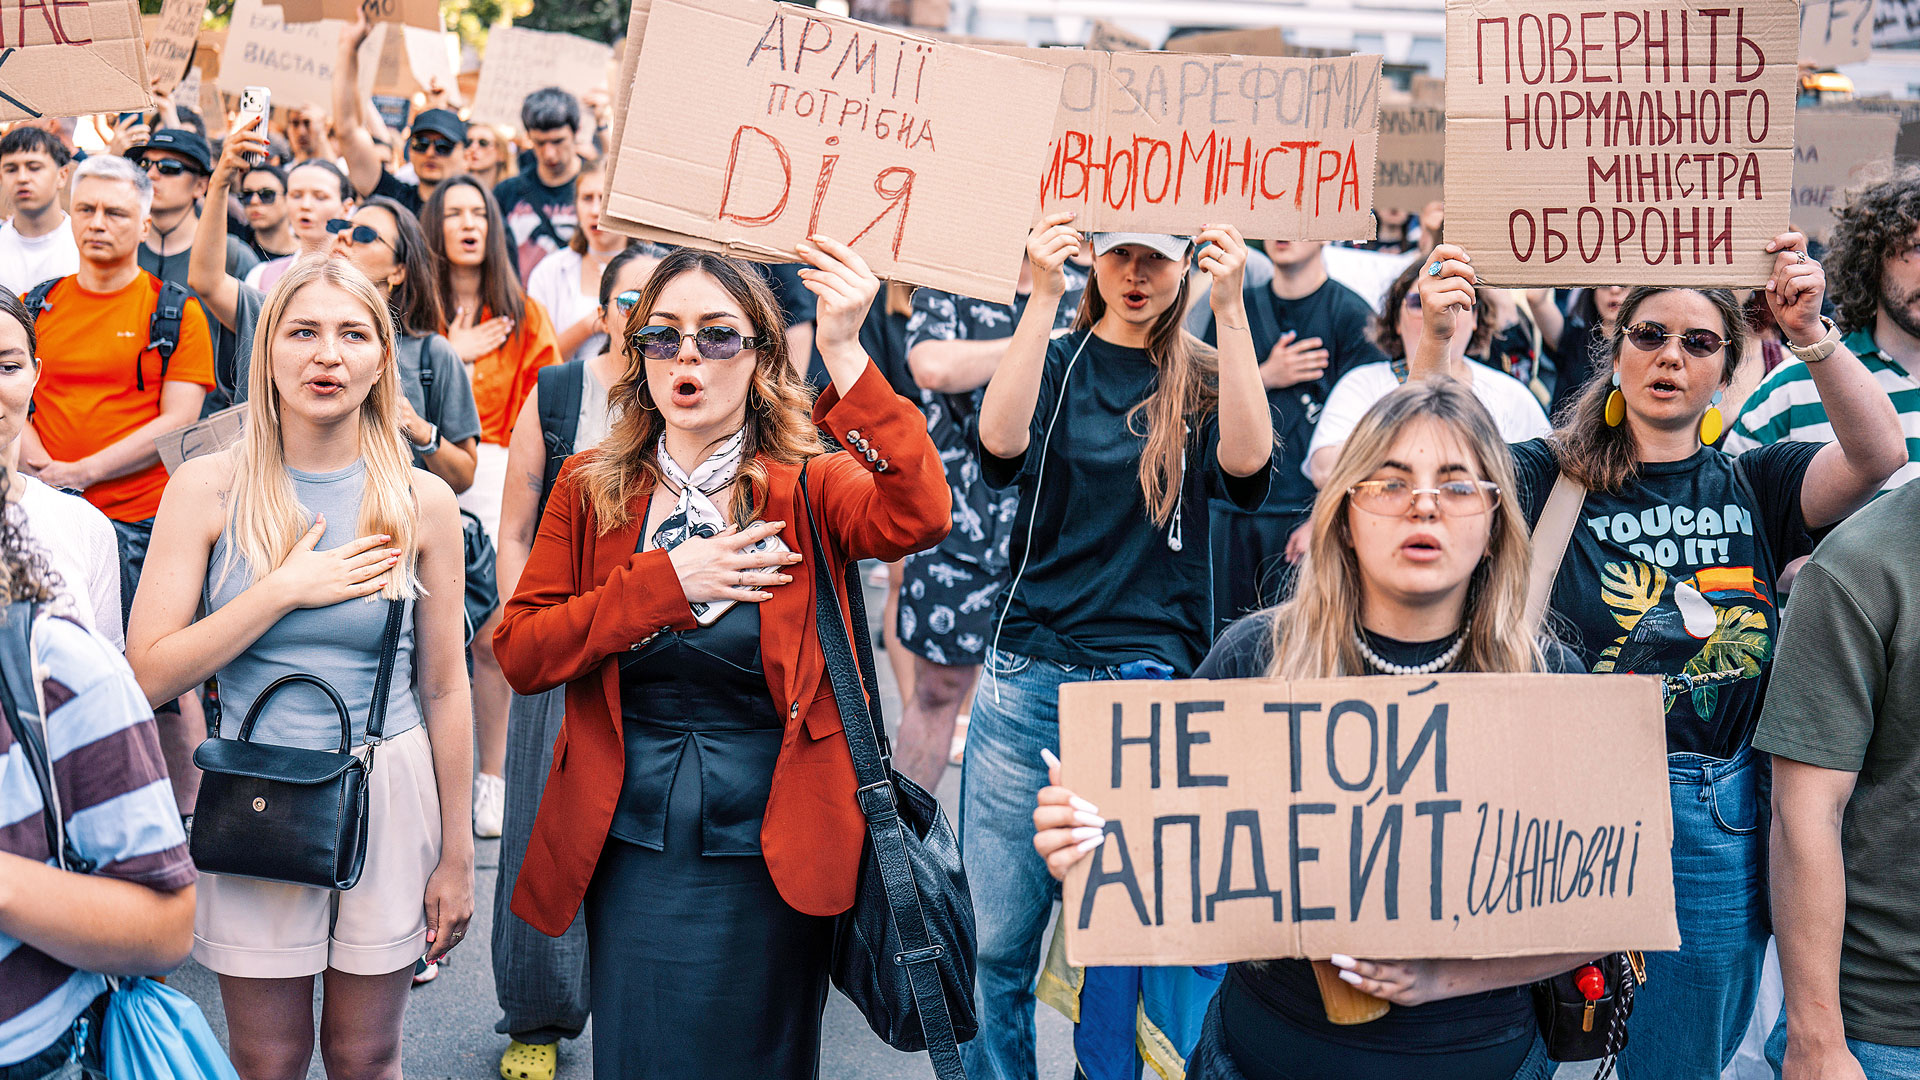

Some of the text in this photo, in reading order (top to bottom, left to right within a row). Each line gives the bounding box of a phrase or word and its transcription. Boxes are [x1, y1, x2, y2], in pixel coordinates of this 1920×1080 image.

[1477, 7, 1766, 85] ПОВЕРНІТЬ
[1504, 88, 1770, 151] НОРМАЛЬНОГО
[1587, 152, 1763, 203] МІНІСТРА
[1509, 206, 1734, 266] ОБОРОНИ
[1587, 504, 1754, 543] TOUCAN
[1628, 537, 1730, 568] DO IT!
[1111, 680, 1450, 795] НЕ ТОЙ
[1078, 786, 1643, 931] АПДЕЙТ, ШАНОВНІ
